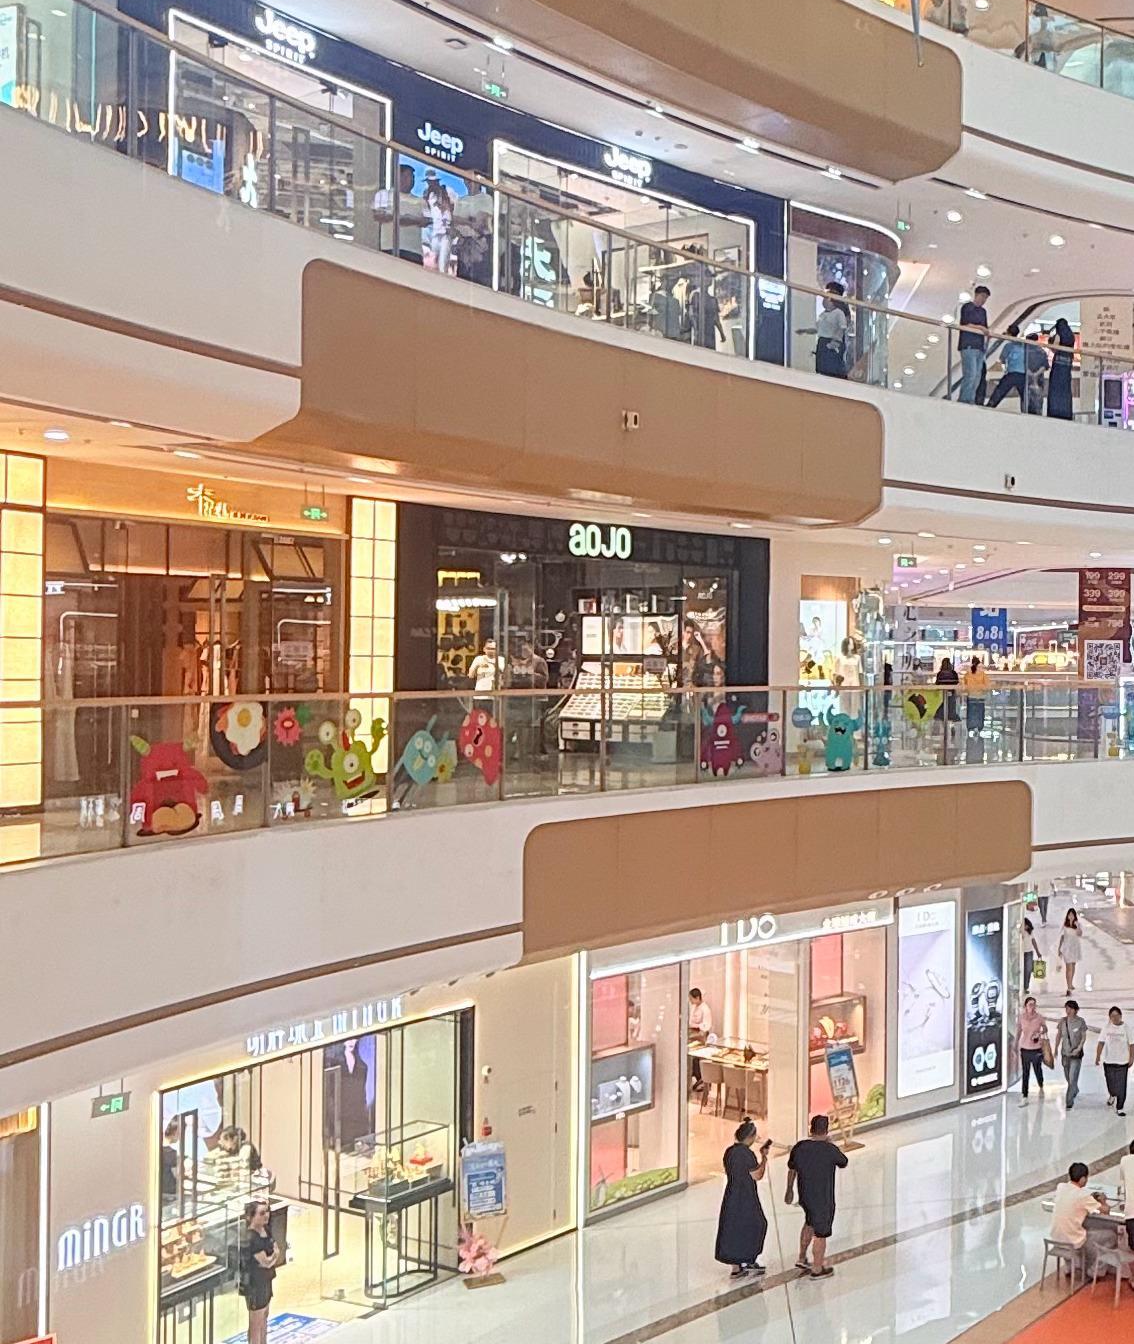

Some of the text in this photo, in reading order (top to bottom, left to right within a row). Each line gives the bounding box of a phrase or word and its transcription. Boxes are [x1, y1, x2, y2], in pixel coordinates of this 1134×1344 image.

[255, 8, 317, 53] Jeep
[266, 39, 307, 64] SPIRIT
[417, 122, 464, 154] Jeep
[424, 146, 457, 163] SPIRIT
[604, 146, 652, 178] Jeep
[611, 170, 643, 188] SPIRIT
